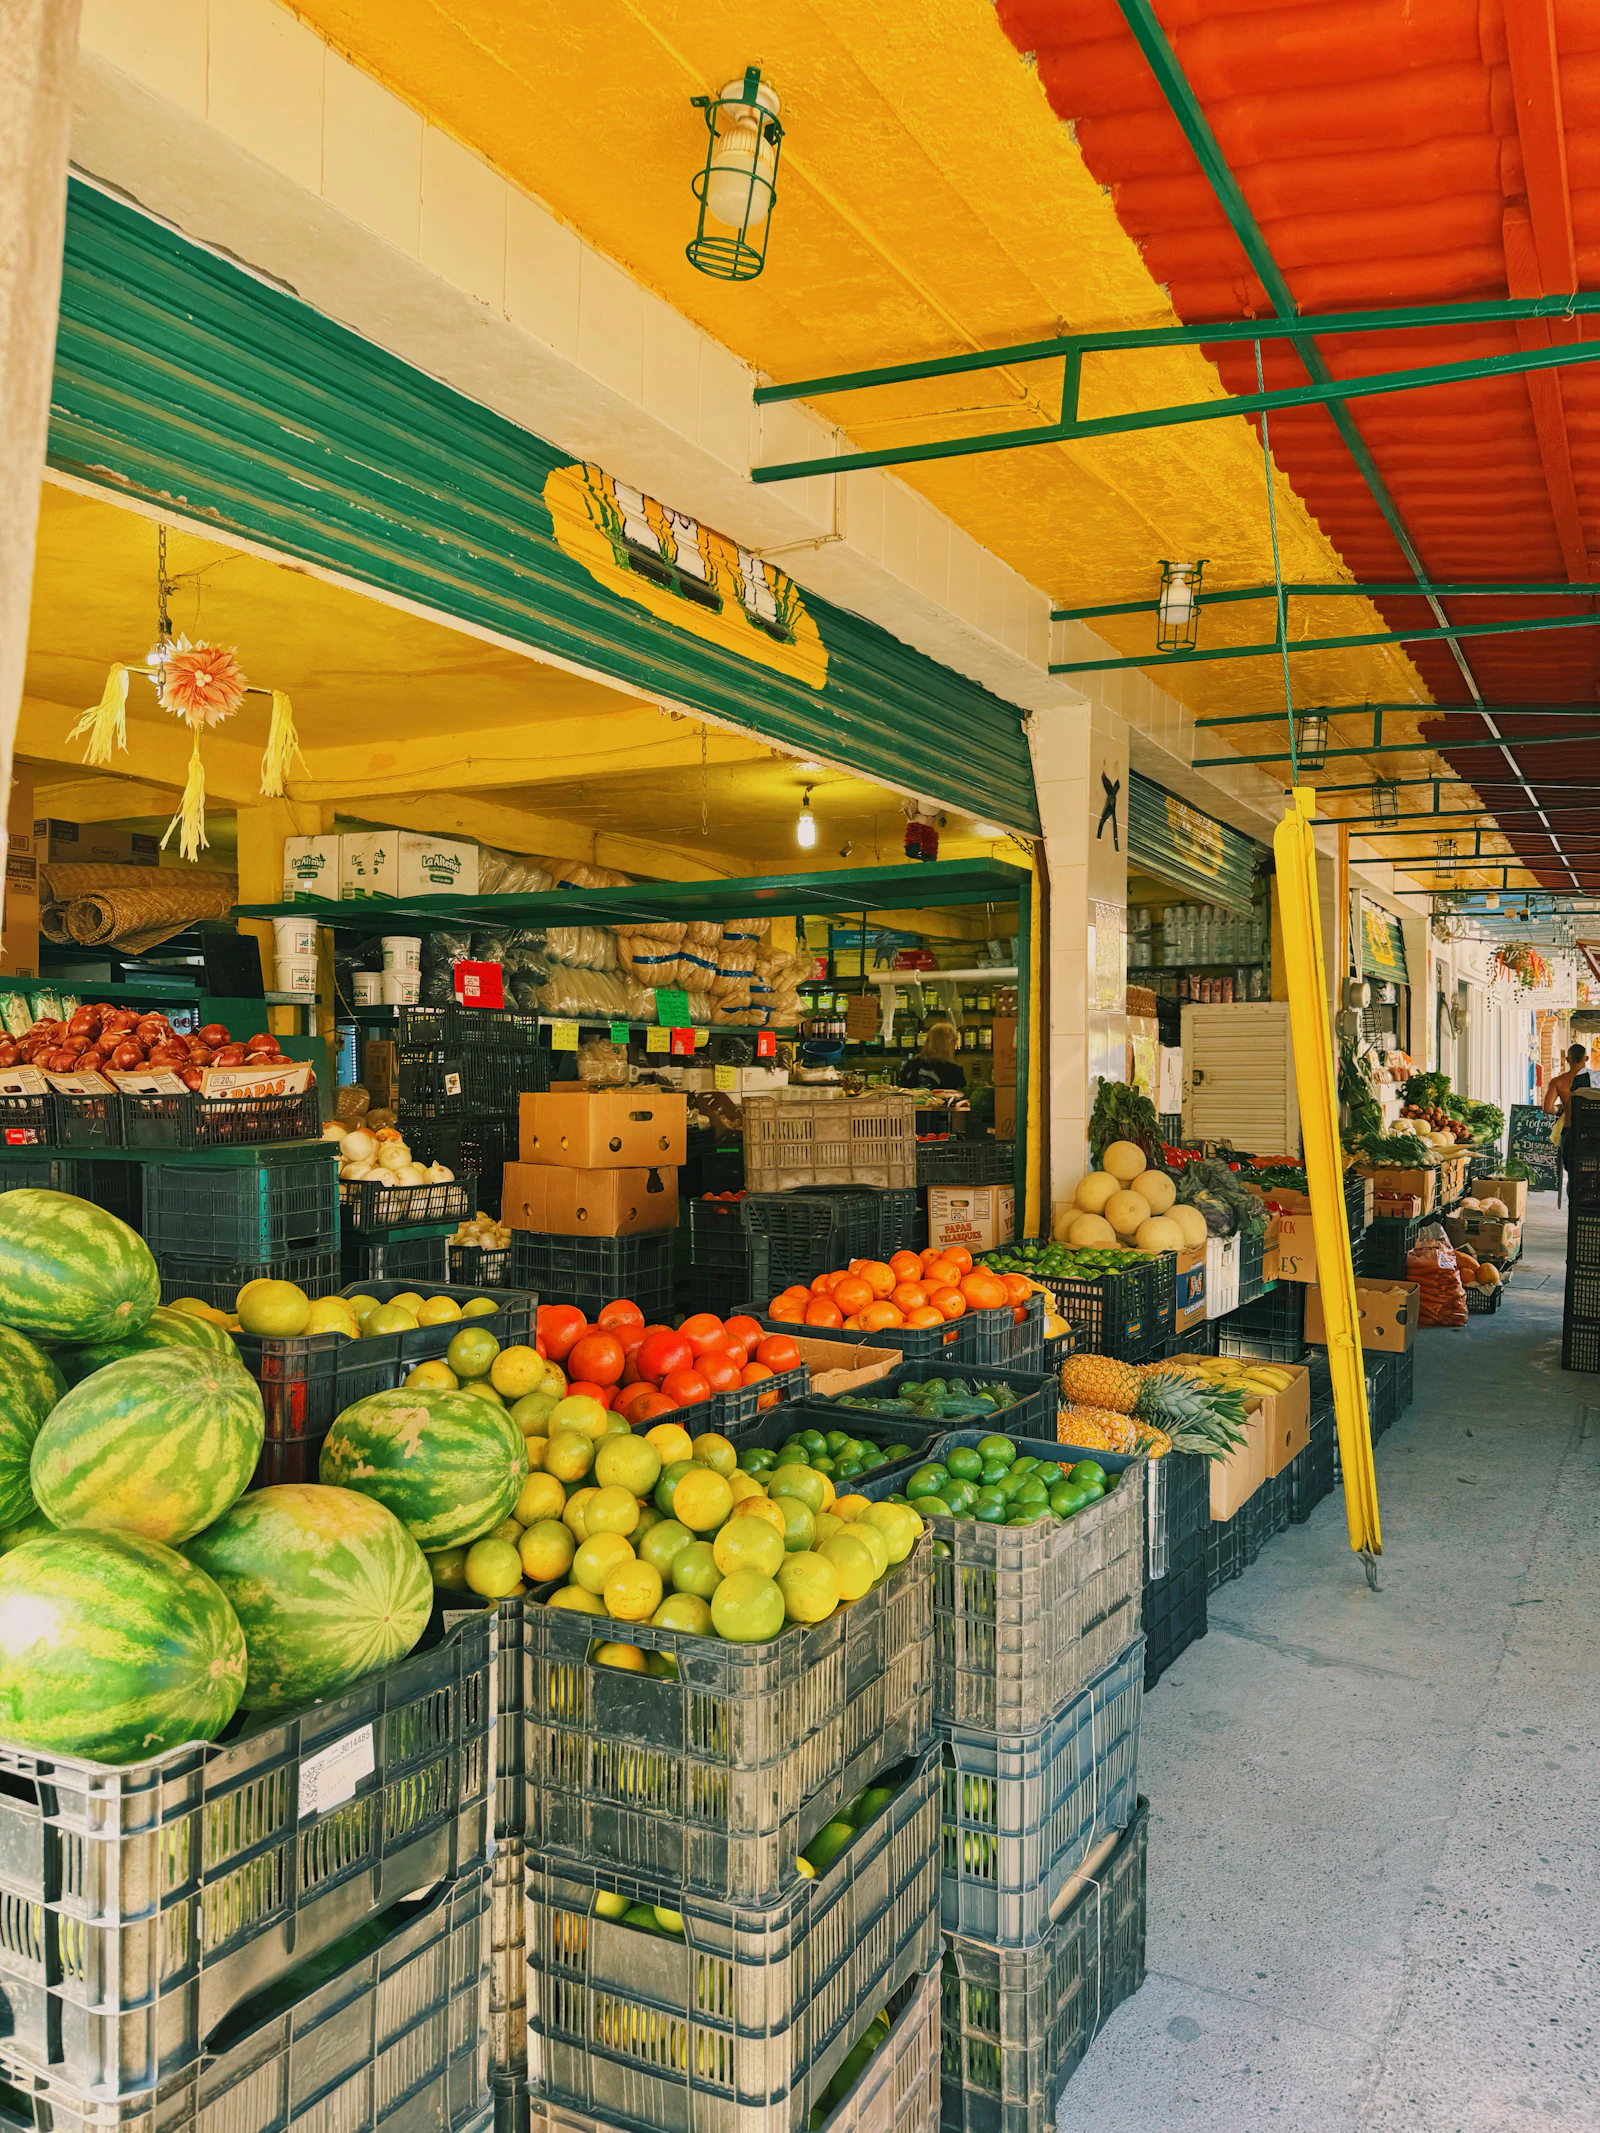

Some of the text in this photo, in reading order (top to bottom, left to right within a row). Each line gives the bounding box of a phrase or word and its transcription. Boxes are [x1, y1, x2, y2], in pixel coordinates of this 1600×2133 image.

[95, 848, 116, 856] DART
[422, 854, 460, 873] La Alteña
[220, 1076, 230, 1085] 20
[231, 1079, 285, 1098] PAPAS
[944, 1223, 972, 1234] PAPAS
[939, 1231, 982, 1242] VELAZQUEZ
[340, 1729, 371, 1754] 3014485
